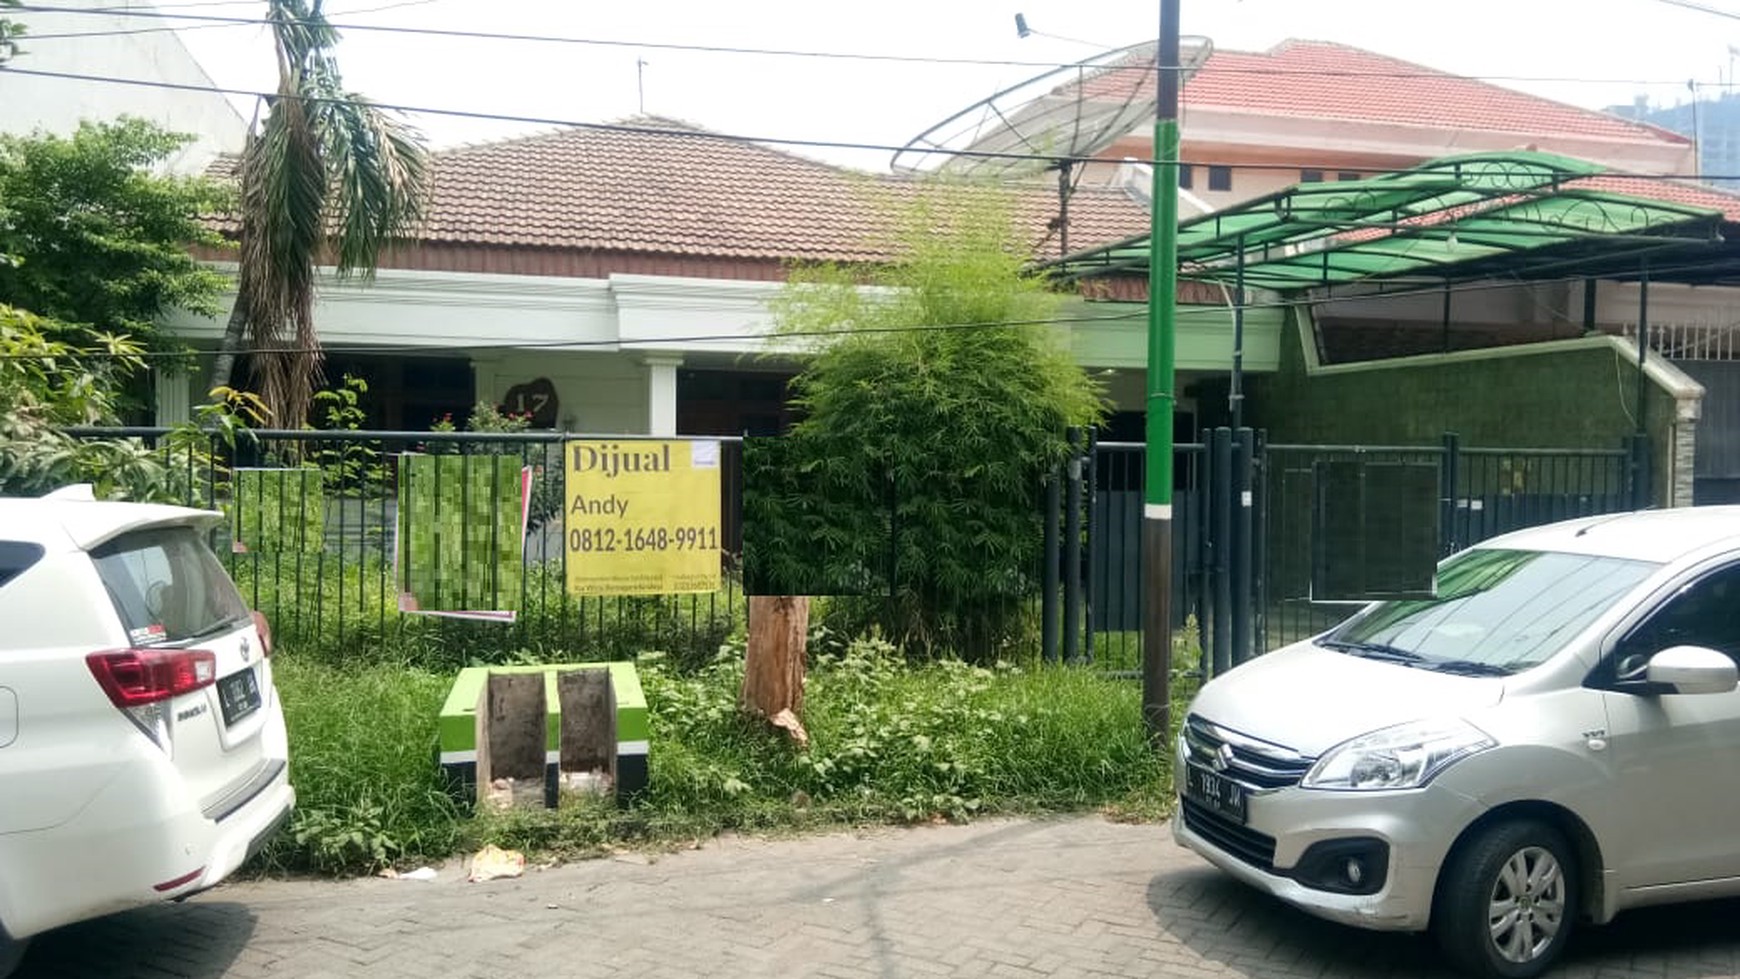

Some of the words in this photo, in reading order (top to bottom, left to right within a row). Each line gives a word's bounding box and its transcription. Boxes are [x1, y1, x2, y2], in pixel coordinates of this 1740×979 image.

[516, 393, 549, 413] 17
[573, 444, 670, 477] Dijual
[571, 494, 629, 519] Andy
[570, 527, 718, 552] 0812-1648-9911
